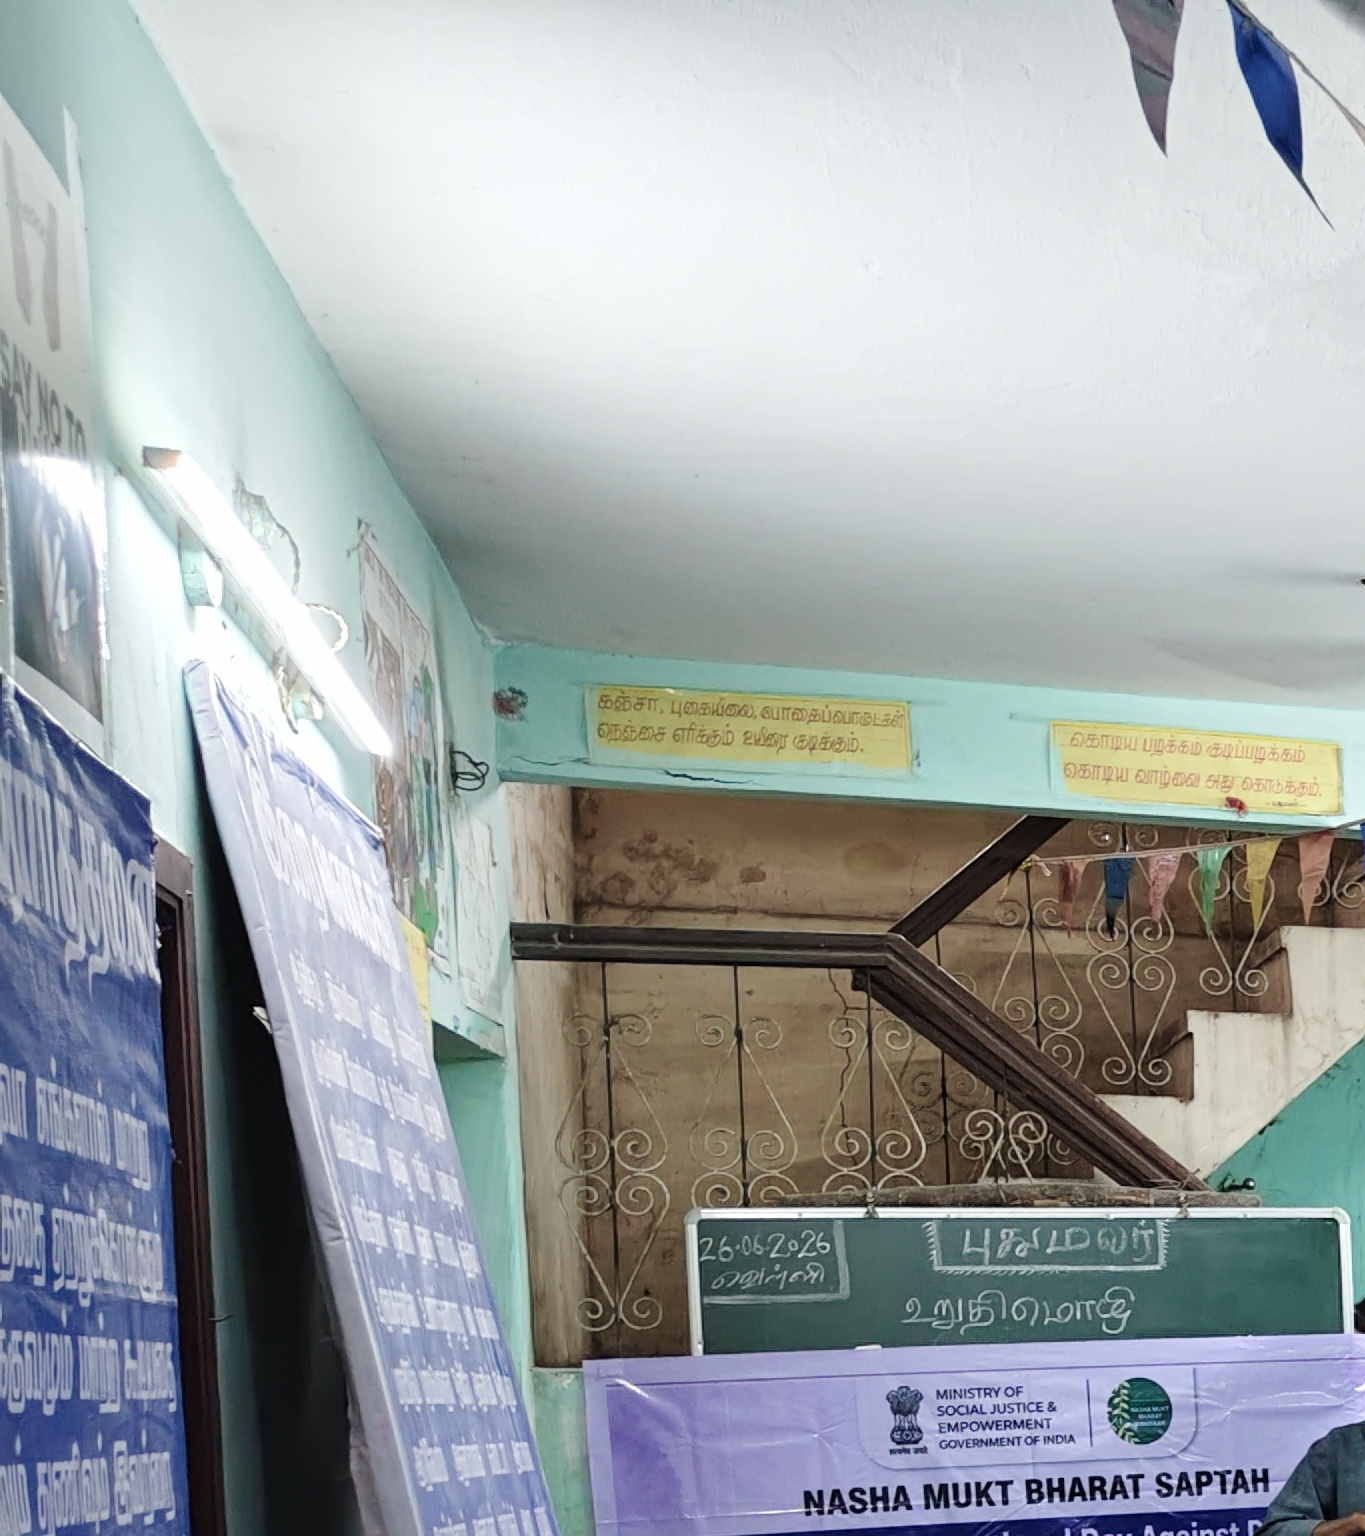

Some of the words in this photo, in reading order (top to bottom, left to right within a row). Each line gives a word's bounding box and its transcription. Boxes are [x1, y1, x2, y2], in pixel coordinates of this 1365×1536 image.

[961, 1220, 1154, 1265] புதுமலர்
[901, 1286, 1136, 1337] உறுதிமொழி
[935, 1386, 1001, 1400] MINISTRY
[1004, 1385, 1024, 1398] OF
[936, 1404, 987, 1417] SOCIAL
[990, 1402, 1045, 1415] JUSTICE
[1047, 1401, 1057, 1412] &
[938, 1418, 1053, 1433] EMPOWERMENT
[939, 1436, 1021, 1450] GOVERNMENT
[1023, 1435, 1041, 1447] OF
[1043, 1433, 1076, 1446] INDIA
[803, 1484, 913, 1517] NASHA
[923, 1479, 1013, 1511] MUKT
[1025, 1473, 1145, 1505] BHARAT
[1155, 1467, 1270, 1499] SAPTAH
